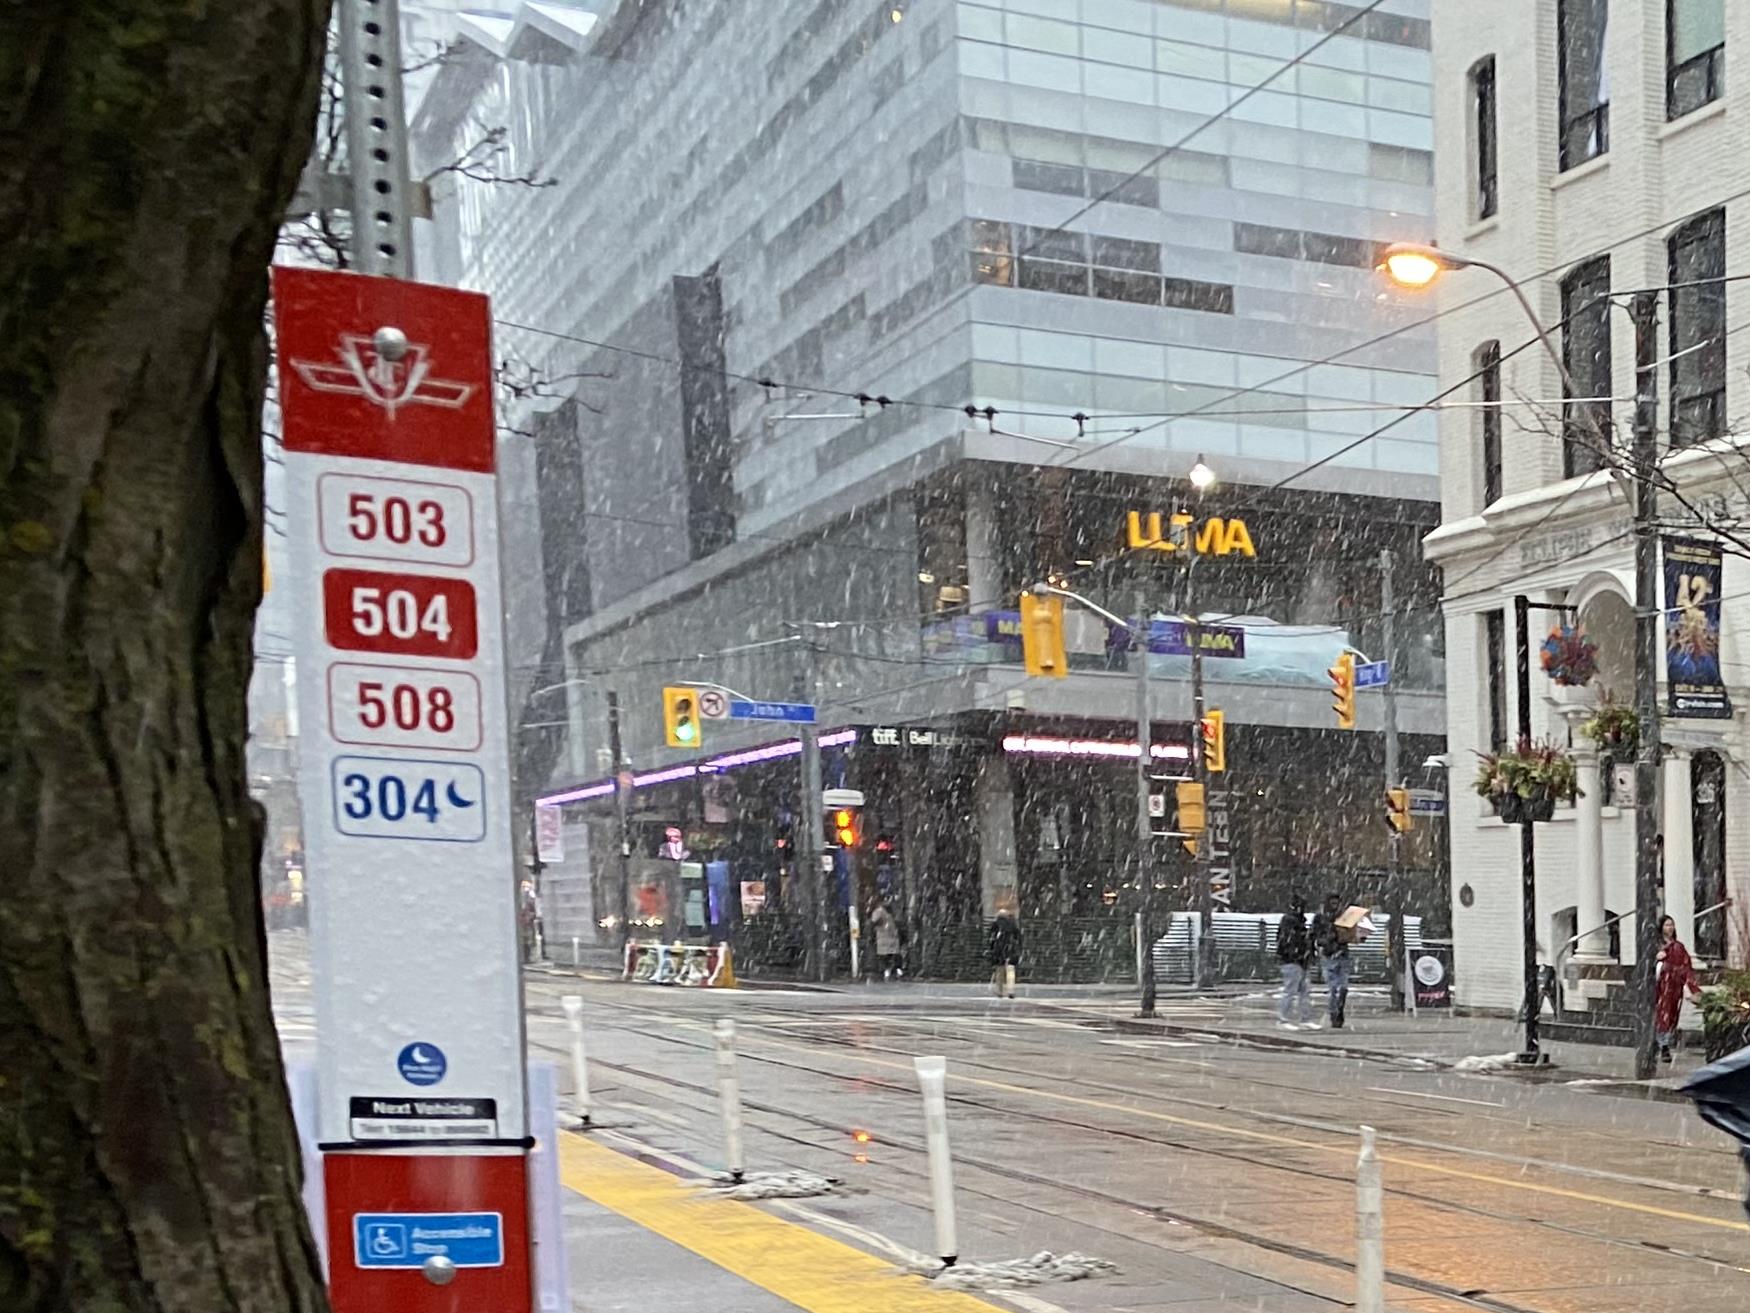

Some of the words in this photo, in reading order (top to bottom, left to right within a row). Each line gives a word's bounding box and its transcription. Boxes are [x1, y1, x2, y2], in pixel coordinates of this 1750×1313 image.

[348, 493, 446, 547] 503
[352, 587, 452, 642] 504
[357, 681, 454, 733] 508
[343, 773, 439, 823] 304
[373, 1102, 411, 1114] Next
[414, 1102, 475, 1115] Vehicle
